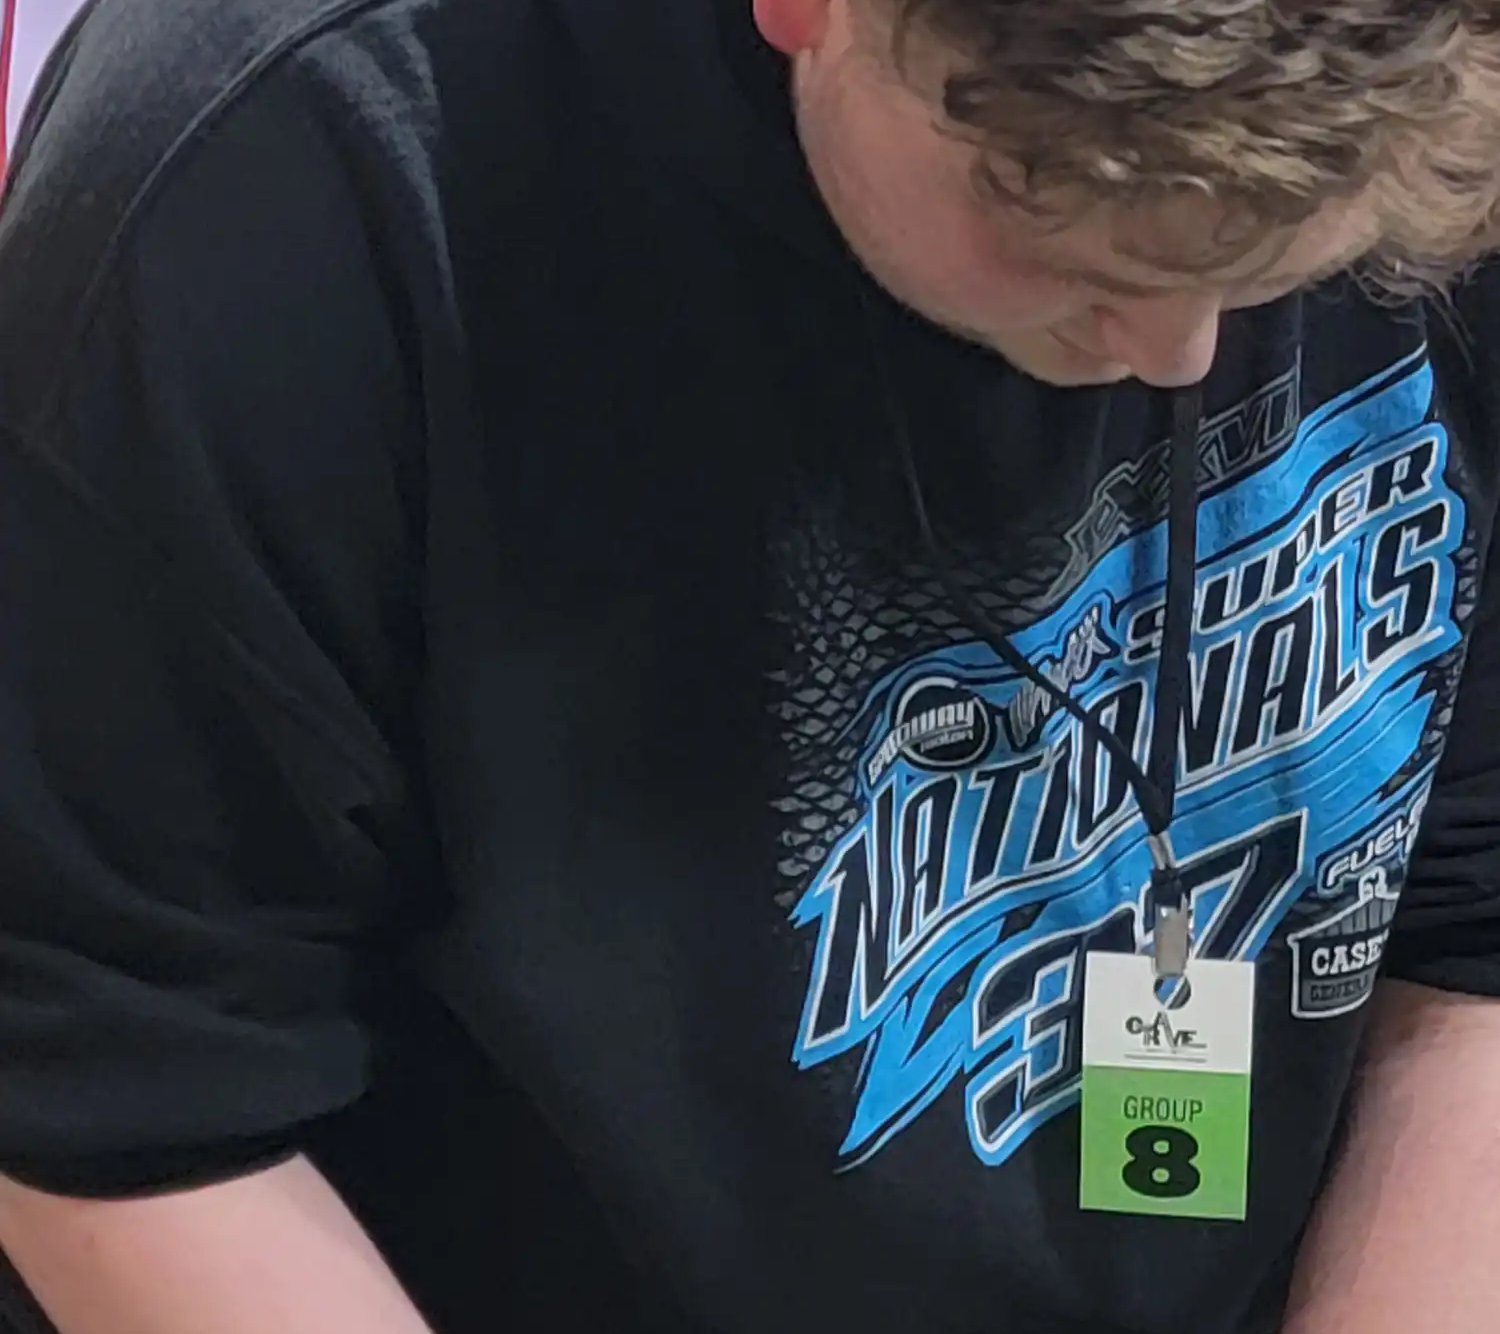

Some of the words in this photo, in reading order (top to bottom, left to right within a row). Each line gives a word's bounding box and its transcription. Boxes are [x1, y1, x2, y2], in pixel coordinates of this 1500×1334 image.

[1122, 435, 1438, 665] SUPER
[1125, 1011, 1207, 1054] CRAVE
[1123, 1095, 1203, 1123] GROUP
[1121, 1124, 1201, 1199] 8
